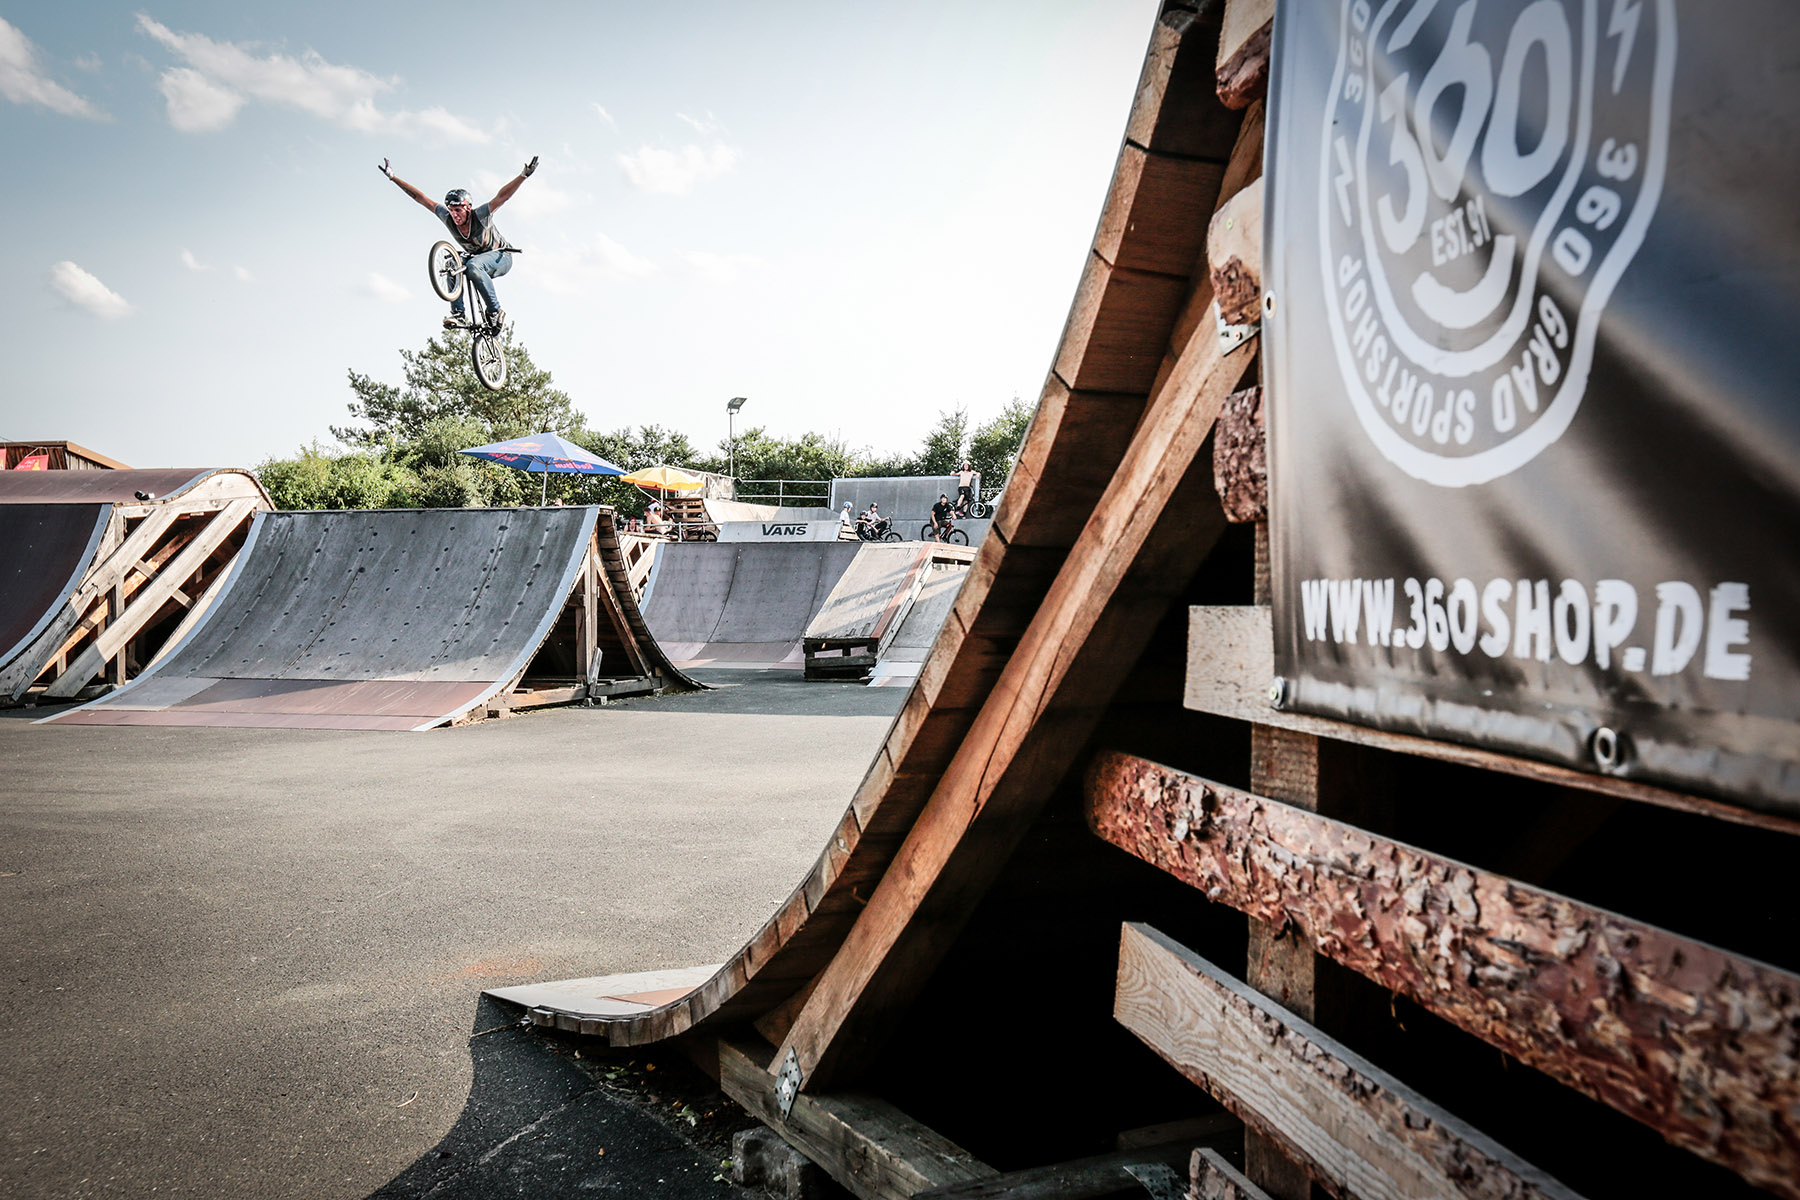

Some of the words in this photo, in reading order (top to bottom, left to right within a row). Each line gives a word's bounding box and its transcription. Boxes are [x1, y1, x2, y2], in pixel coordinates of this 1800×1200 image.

[1344, 0, 1371, 104] 360
[1377, 0, 1574, 255] 360
[1552, 137, 1639, 278] 360
[1338, 254, 1477, 446] SPORTSHOP
[1491, 294, 1570, 434] GRAD
[761, 523, 808, 536] VANS
[1300, 577, 1753, 681] WWW.360SHOP.DE
